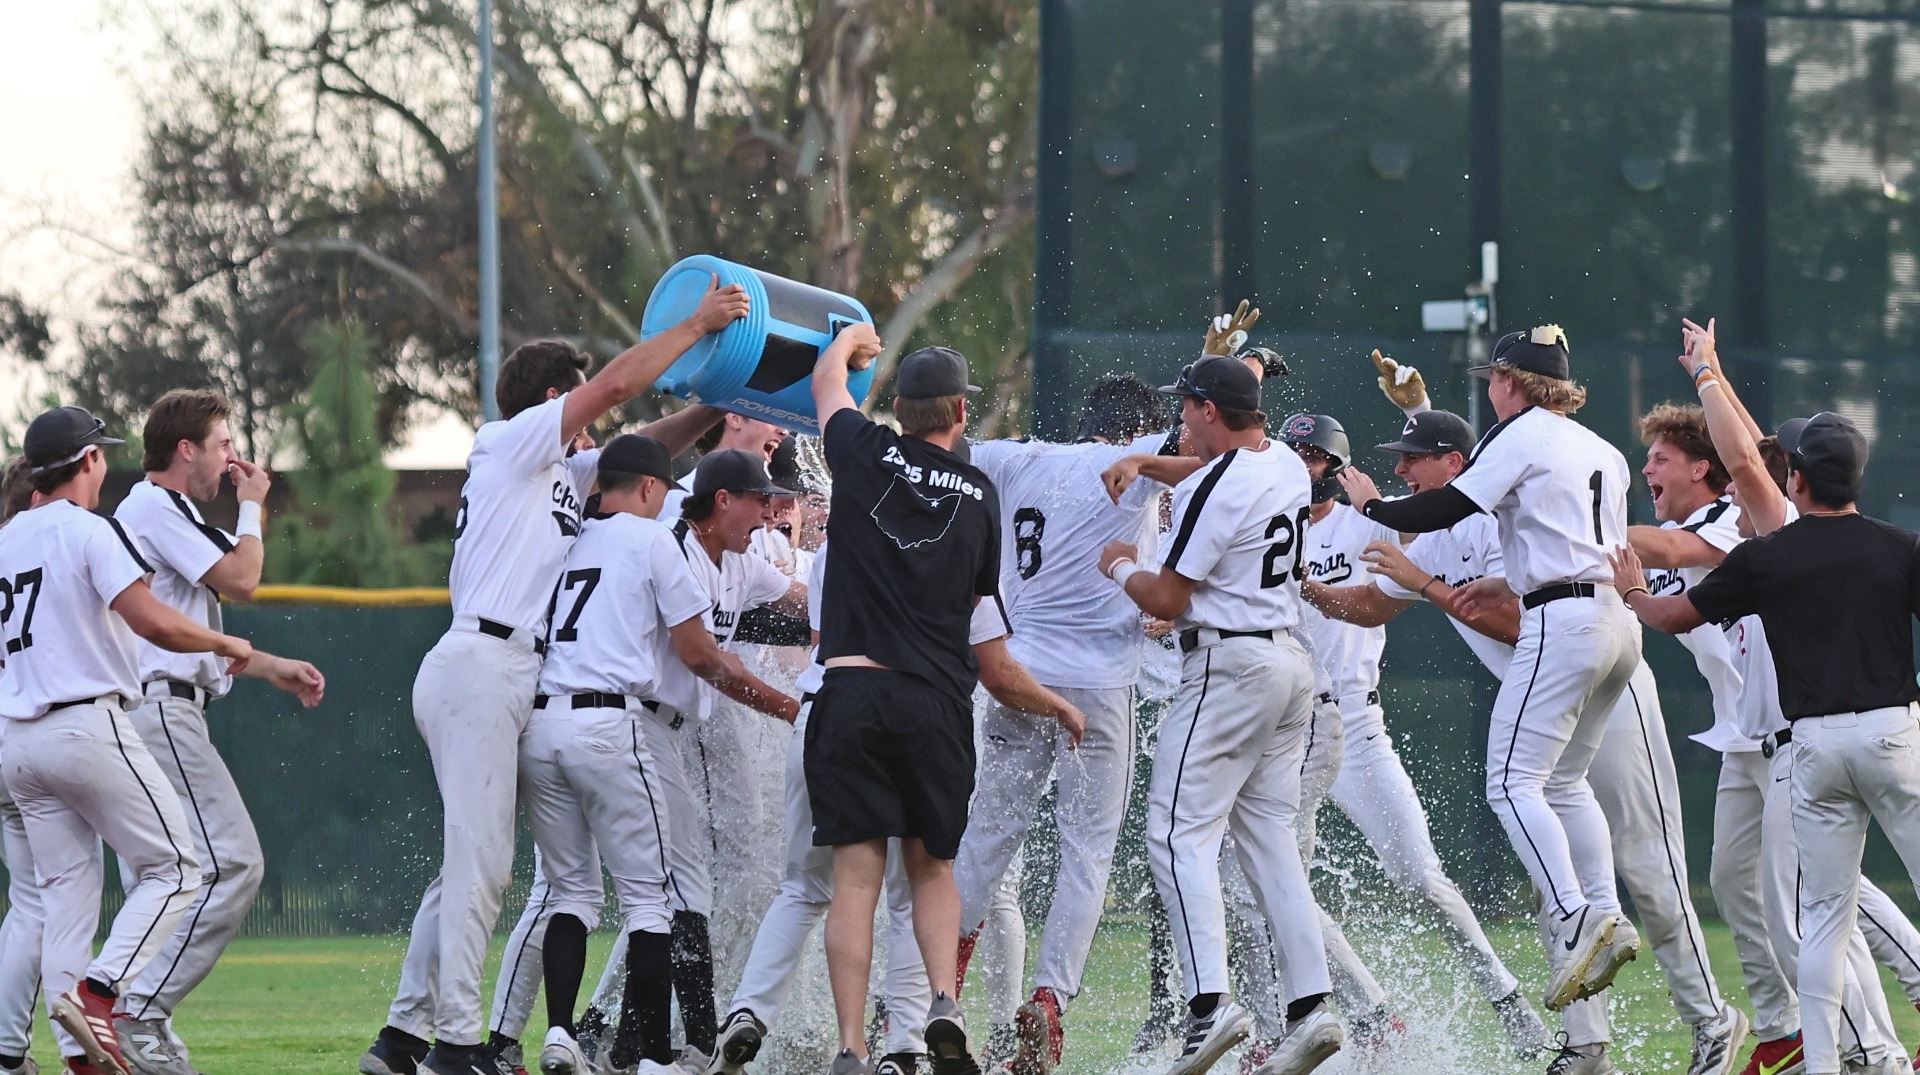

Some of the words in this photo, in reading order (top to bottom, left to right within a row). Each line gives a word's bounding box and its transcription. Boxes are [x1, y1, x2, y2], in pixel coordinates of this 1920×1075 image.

[731, 398, 820, 428] POWERAD
[1402, 417, 1418, 436] C
[928, 469, 983, 501] Miles
[1589, 469, 1604, 546] 1
[1013, 507, 1046, 581] 8
